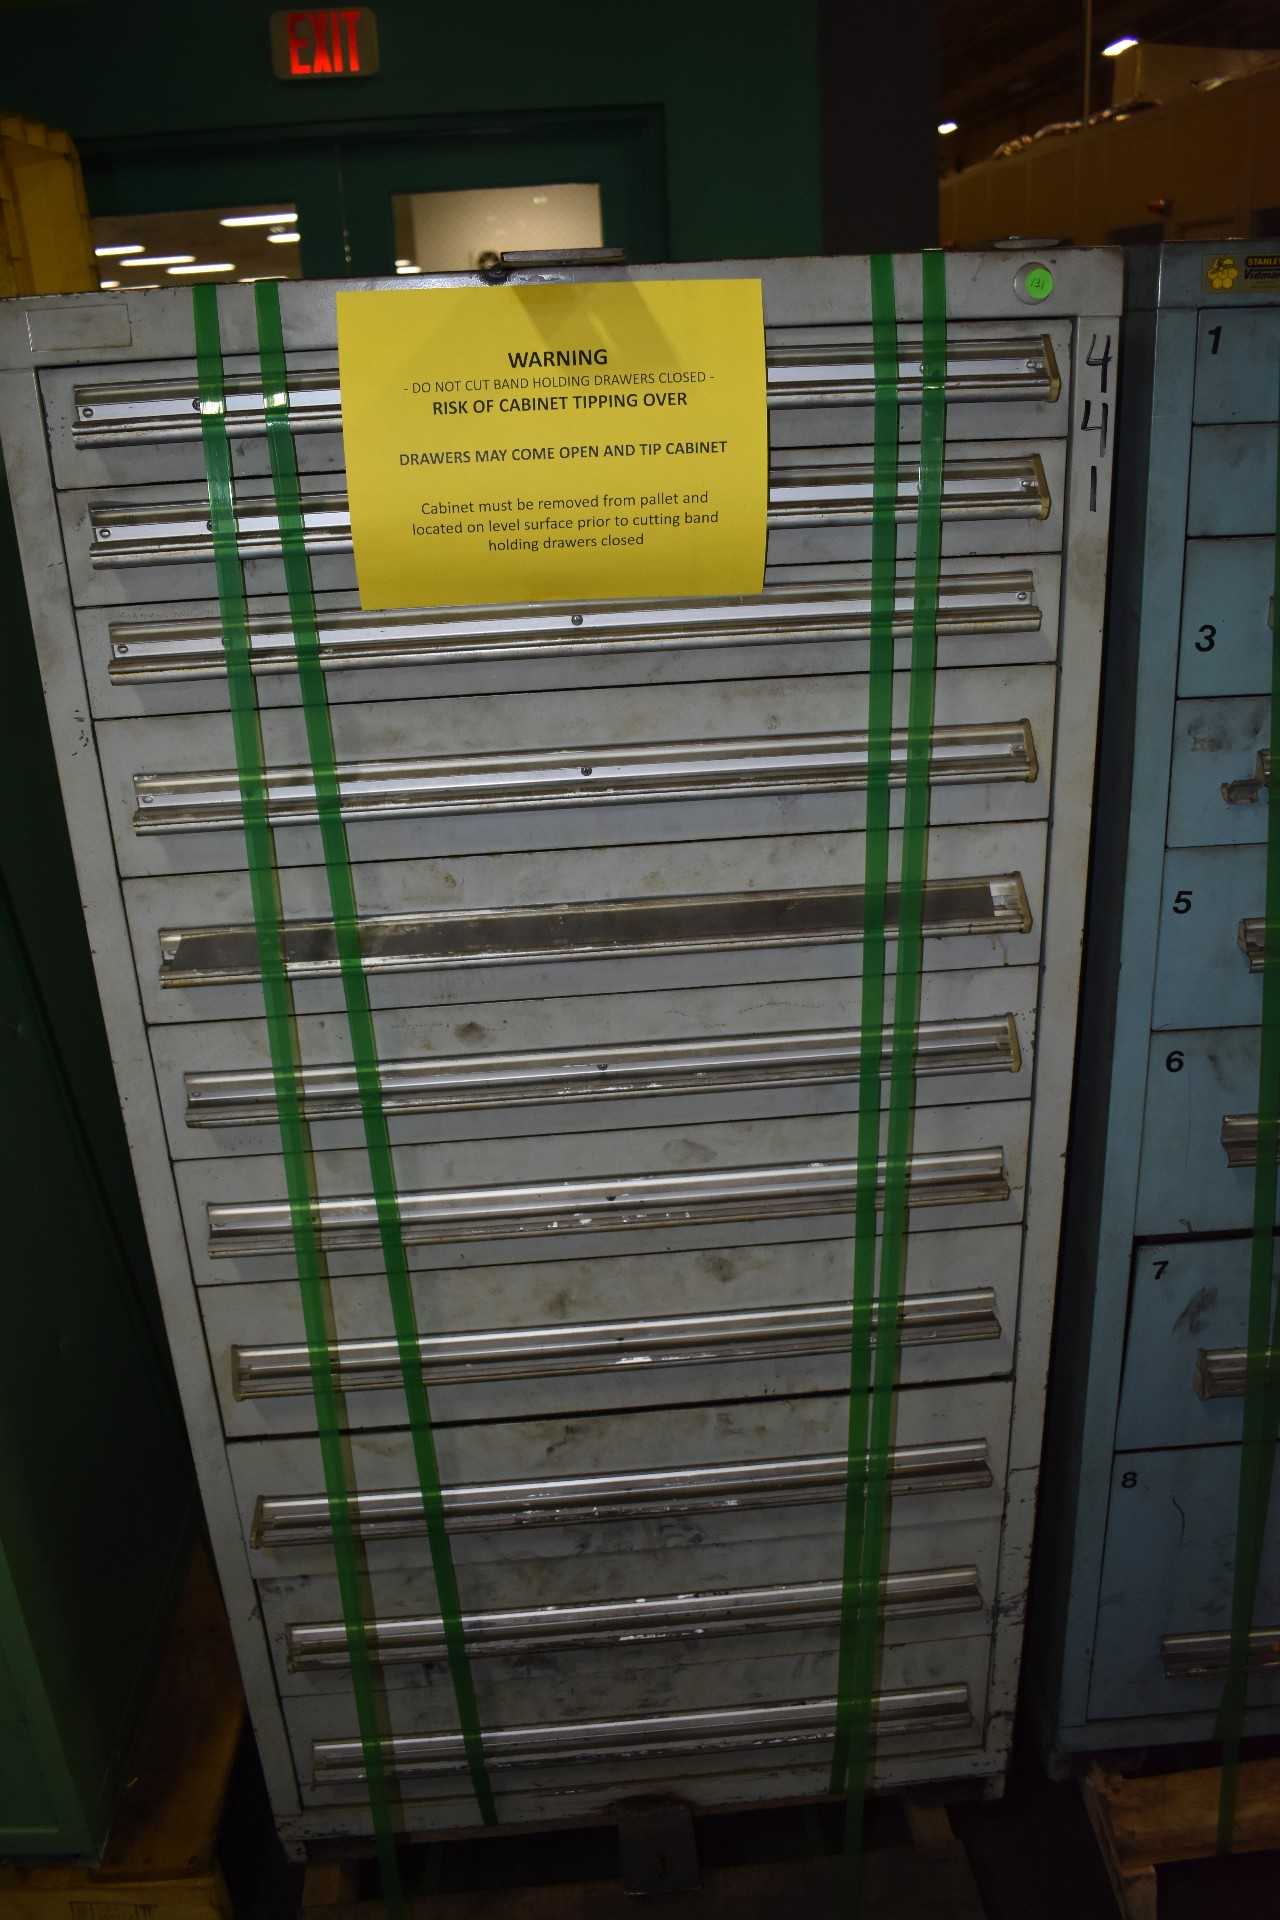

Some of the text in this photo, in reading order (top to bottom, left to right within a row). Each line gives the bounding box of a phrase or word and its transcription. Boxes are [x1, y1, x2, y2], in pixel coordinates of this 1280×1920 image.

[287, 11, 361, 75] EXIT
[1207, 326, 1223, 355] 1
[507, 348, 608, 369] WARNING
[412, 382, 431, 394] DO
[435, 380, 461, 393] NOT
[465, 379, 491, 392] CUT
[493, 377, 529, 391] BAND
[533, 375, 590, 389] HOLDING
[594, 373, 655, 386] DRAWERS
[658, 371, 706, 384] CLOSED
[432, 392, 688, 416] RISK OF CABINET TIPPING OVER
[399, 440, 728, 466] DRAWERS MAY COME OPEN AND TIP CABINET
[421, 491, 708, 516] Cabinet must be removed from pallet and
[412, 510, 718, 536] located on level surface prior to cutting band
[488, 533, 644, 552] holding drawers closed
[1194, 625, 1217, 652] 3
[1172, 891, 1193, 914] 5
[1165, 1050, 1185, 1073] 6
[1152, 1261, 1169, 1280] 7
[1121, 1472, 1138, 1489] 8
